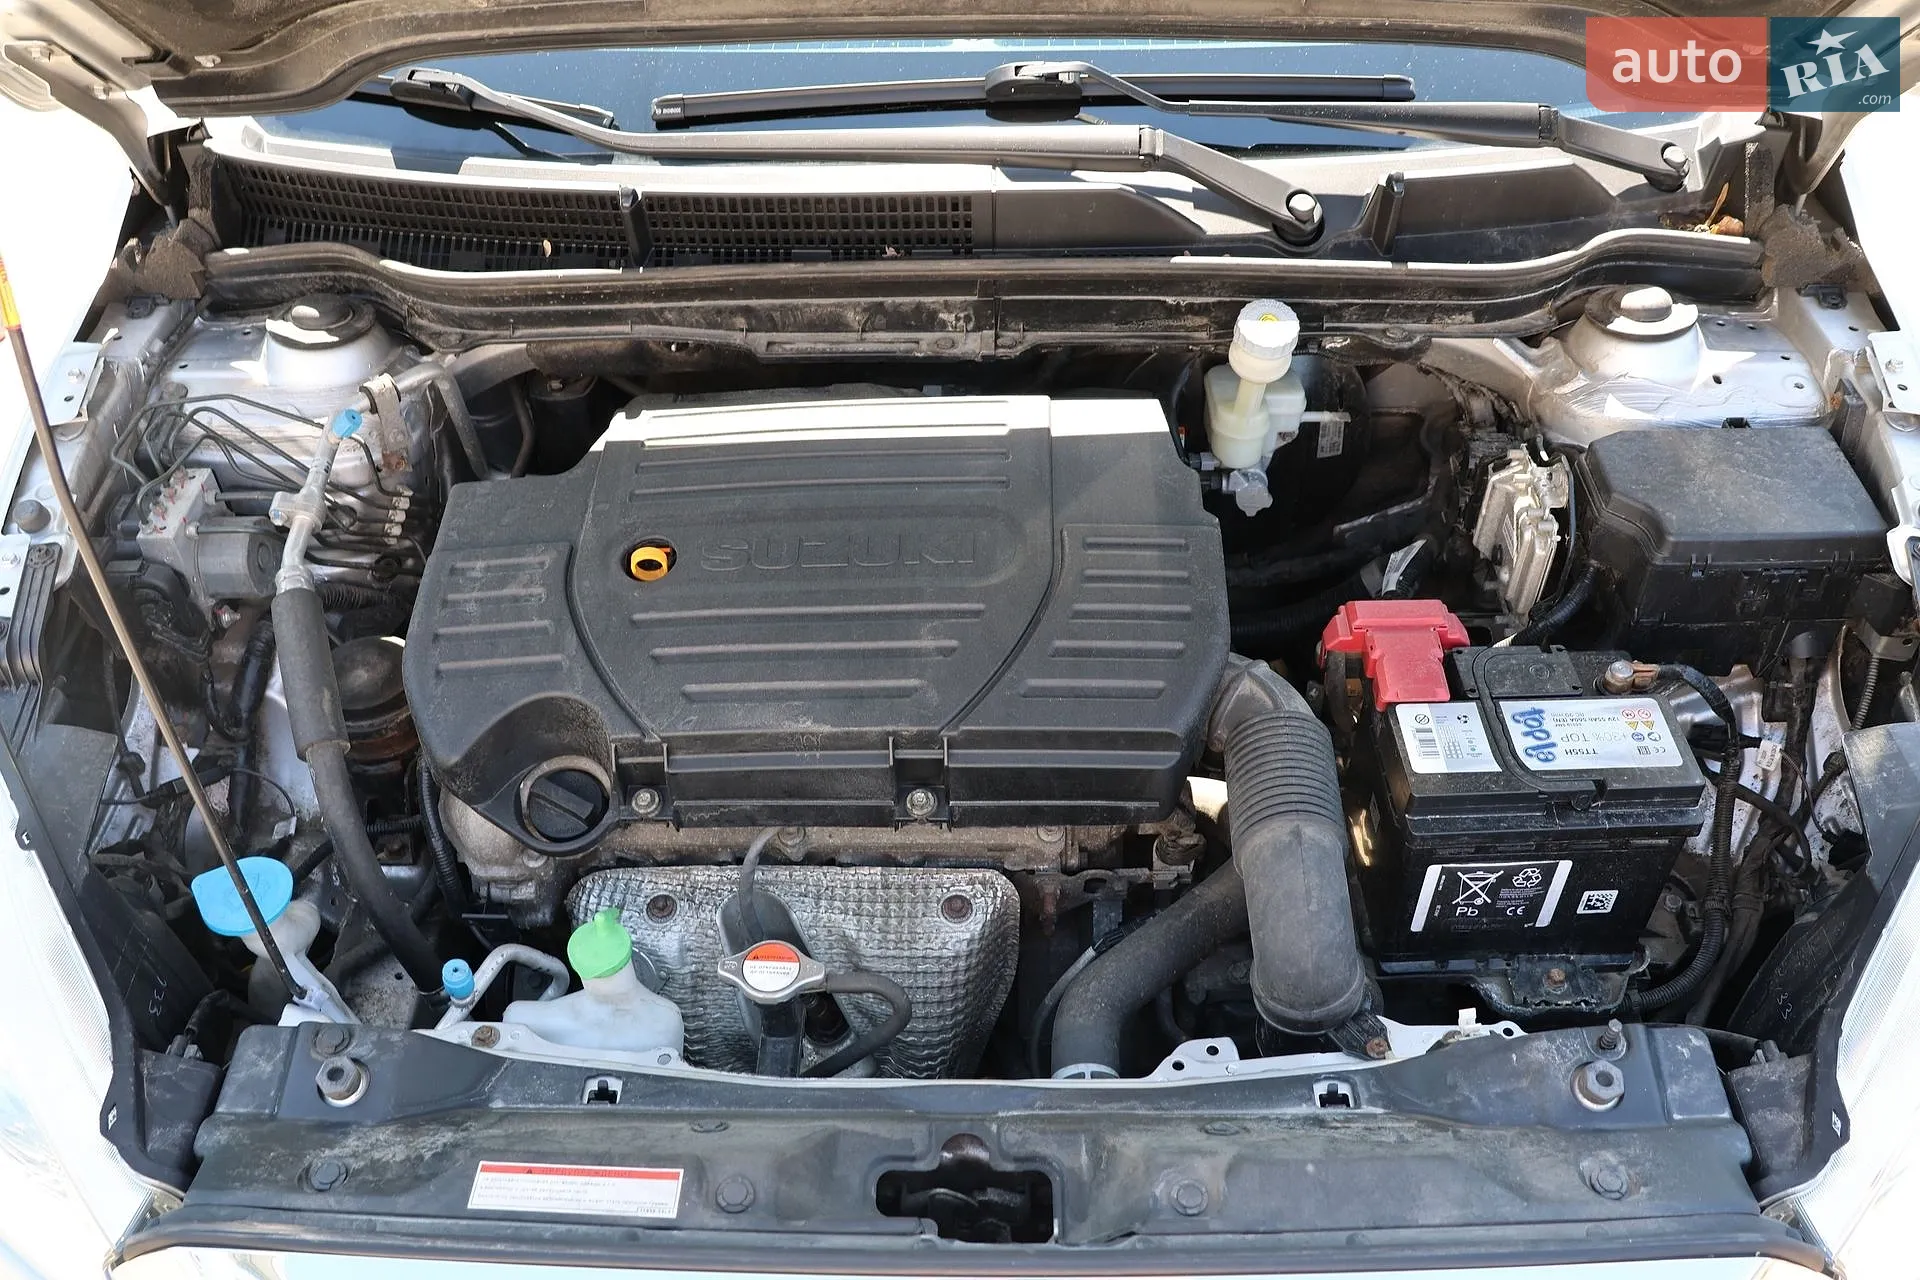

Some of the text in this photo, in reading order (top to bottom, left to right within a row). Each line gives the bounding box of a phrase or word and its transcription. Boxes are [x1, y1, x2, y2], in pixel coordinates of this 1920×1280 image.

[700, 532, 976, 572] SUZUKI
[1560, 733, 1590, 742] TOP
[1455, 906, 1479, 917] Pb
